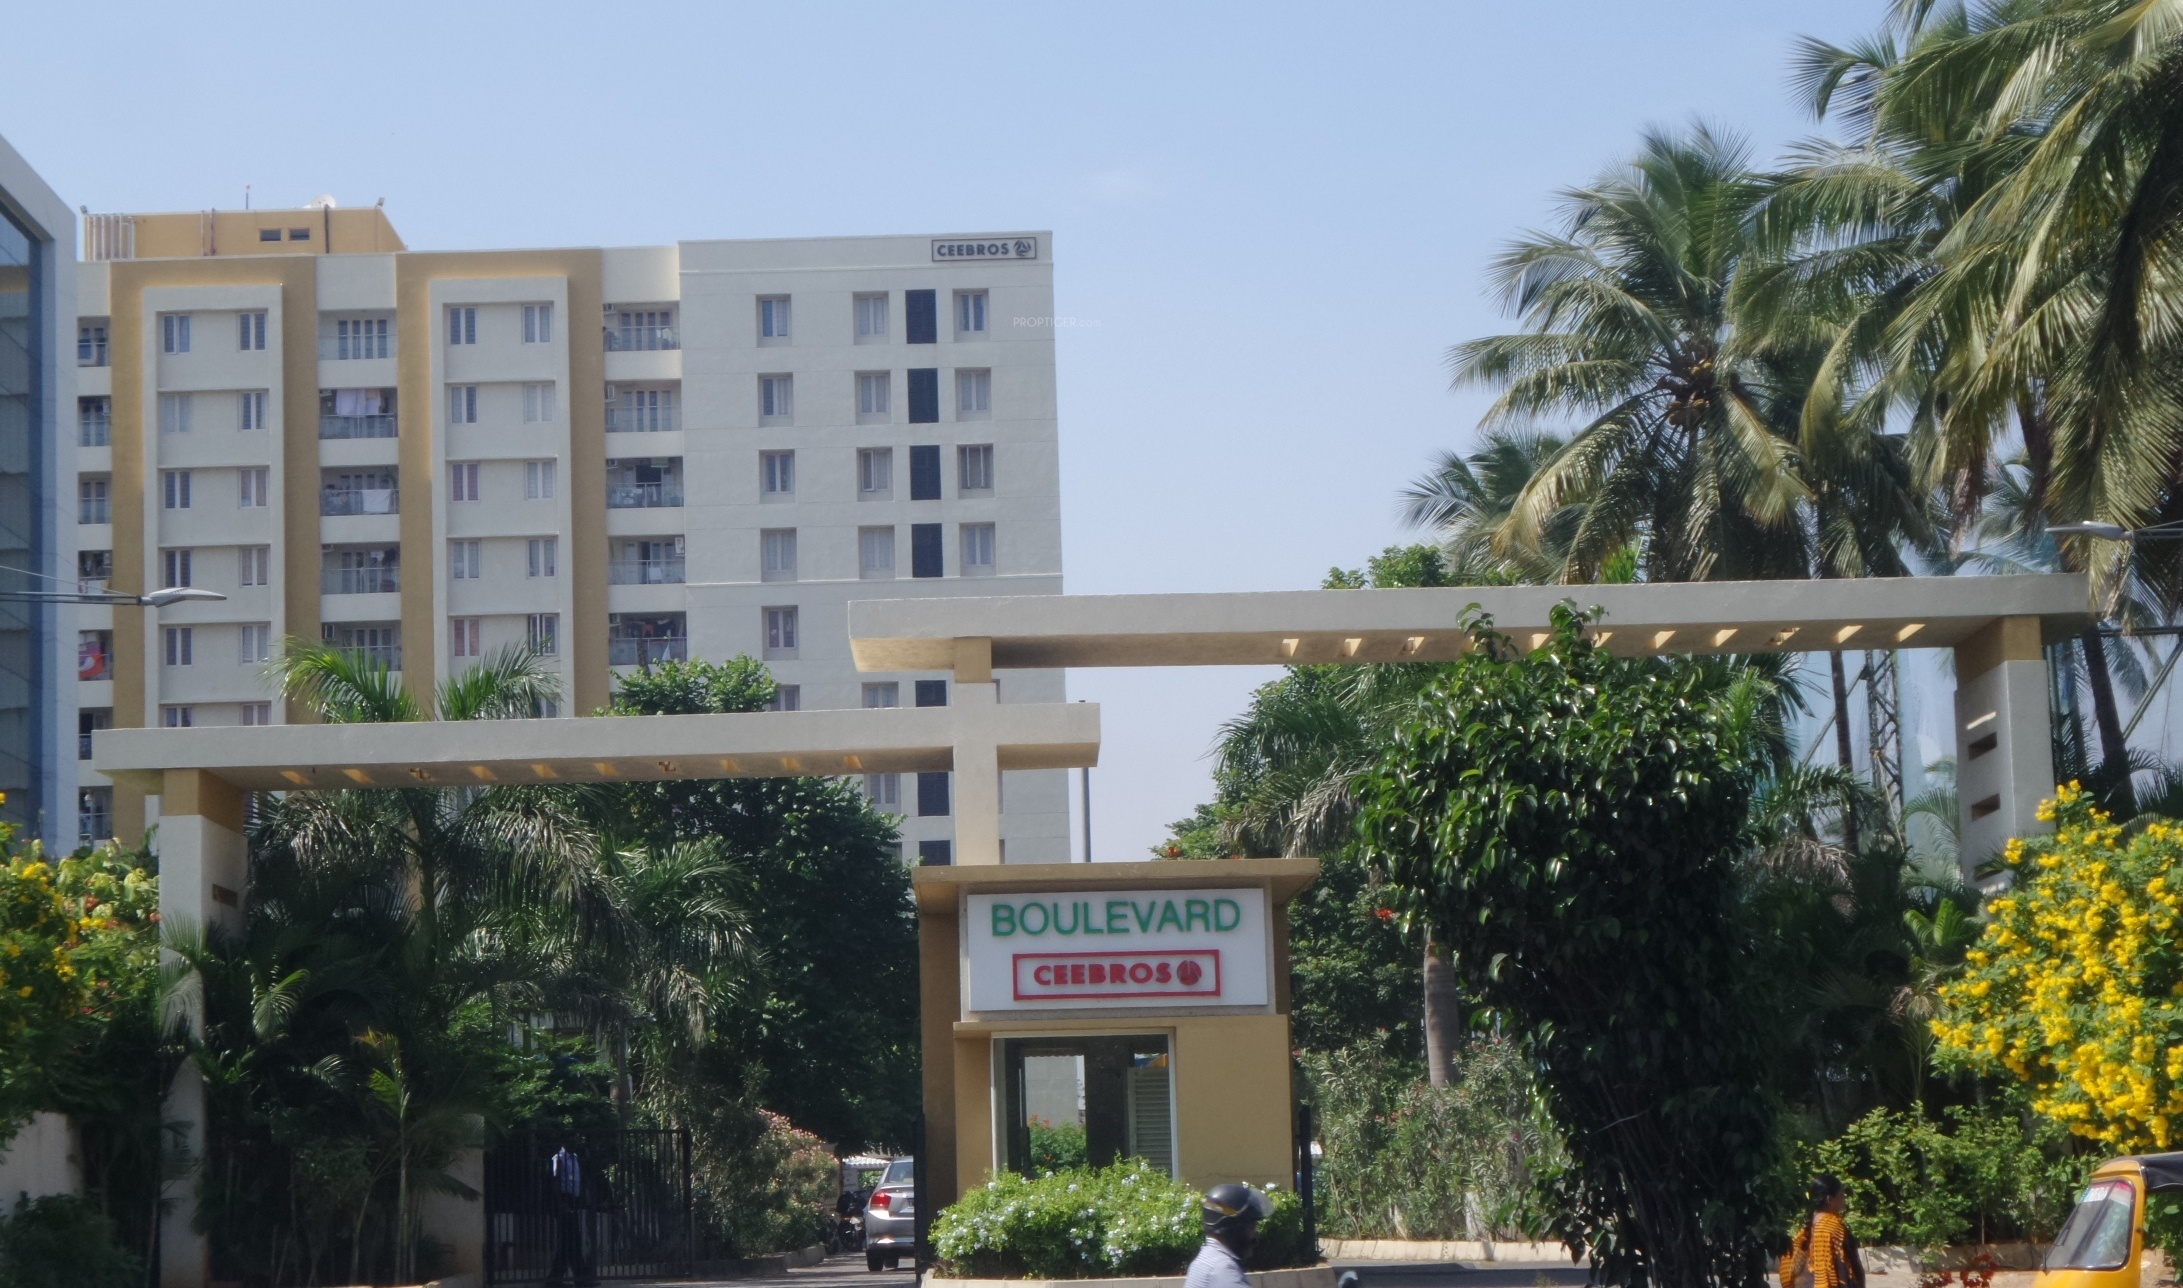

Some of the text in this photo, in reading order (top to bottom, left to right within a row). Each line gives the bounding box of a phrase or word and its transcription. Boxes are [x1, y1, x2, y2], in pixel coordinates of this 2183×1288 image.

[937, 243, 1009, 256] CEEBROS
[991, 899, 1241, 937] BOULEVARD
[1033, 962, 1172, 986] CEEBROS
